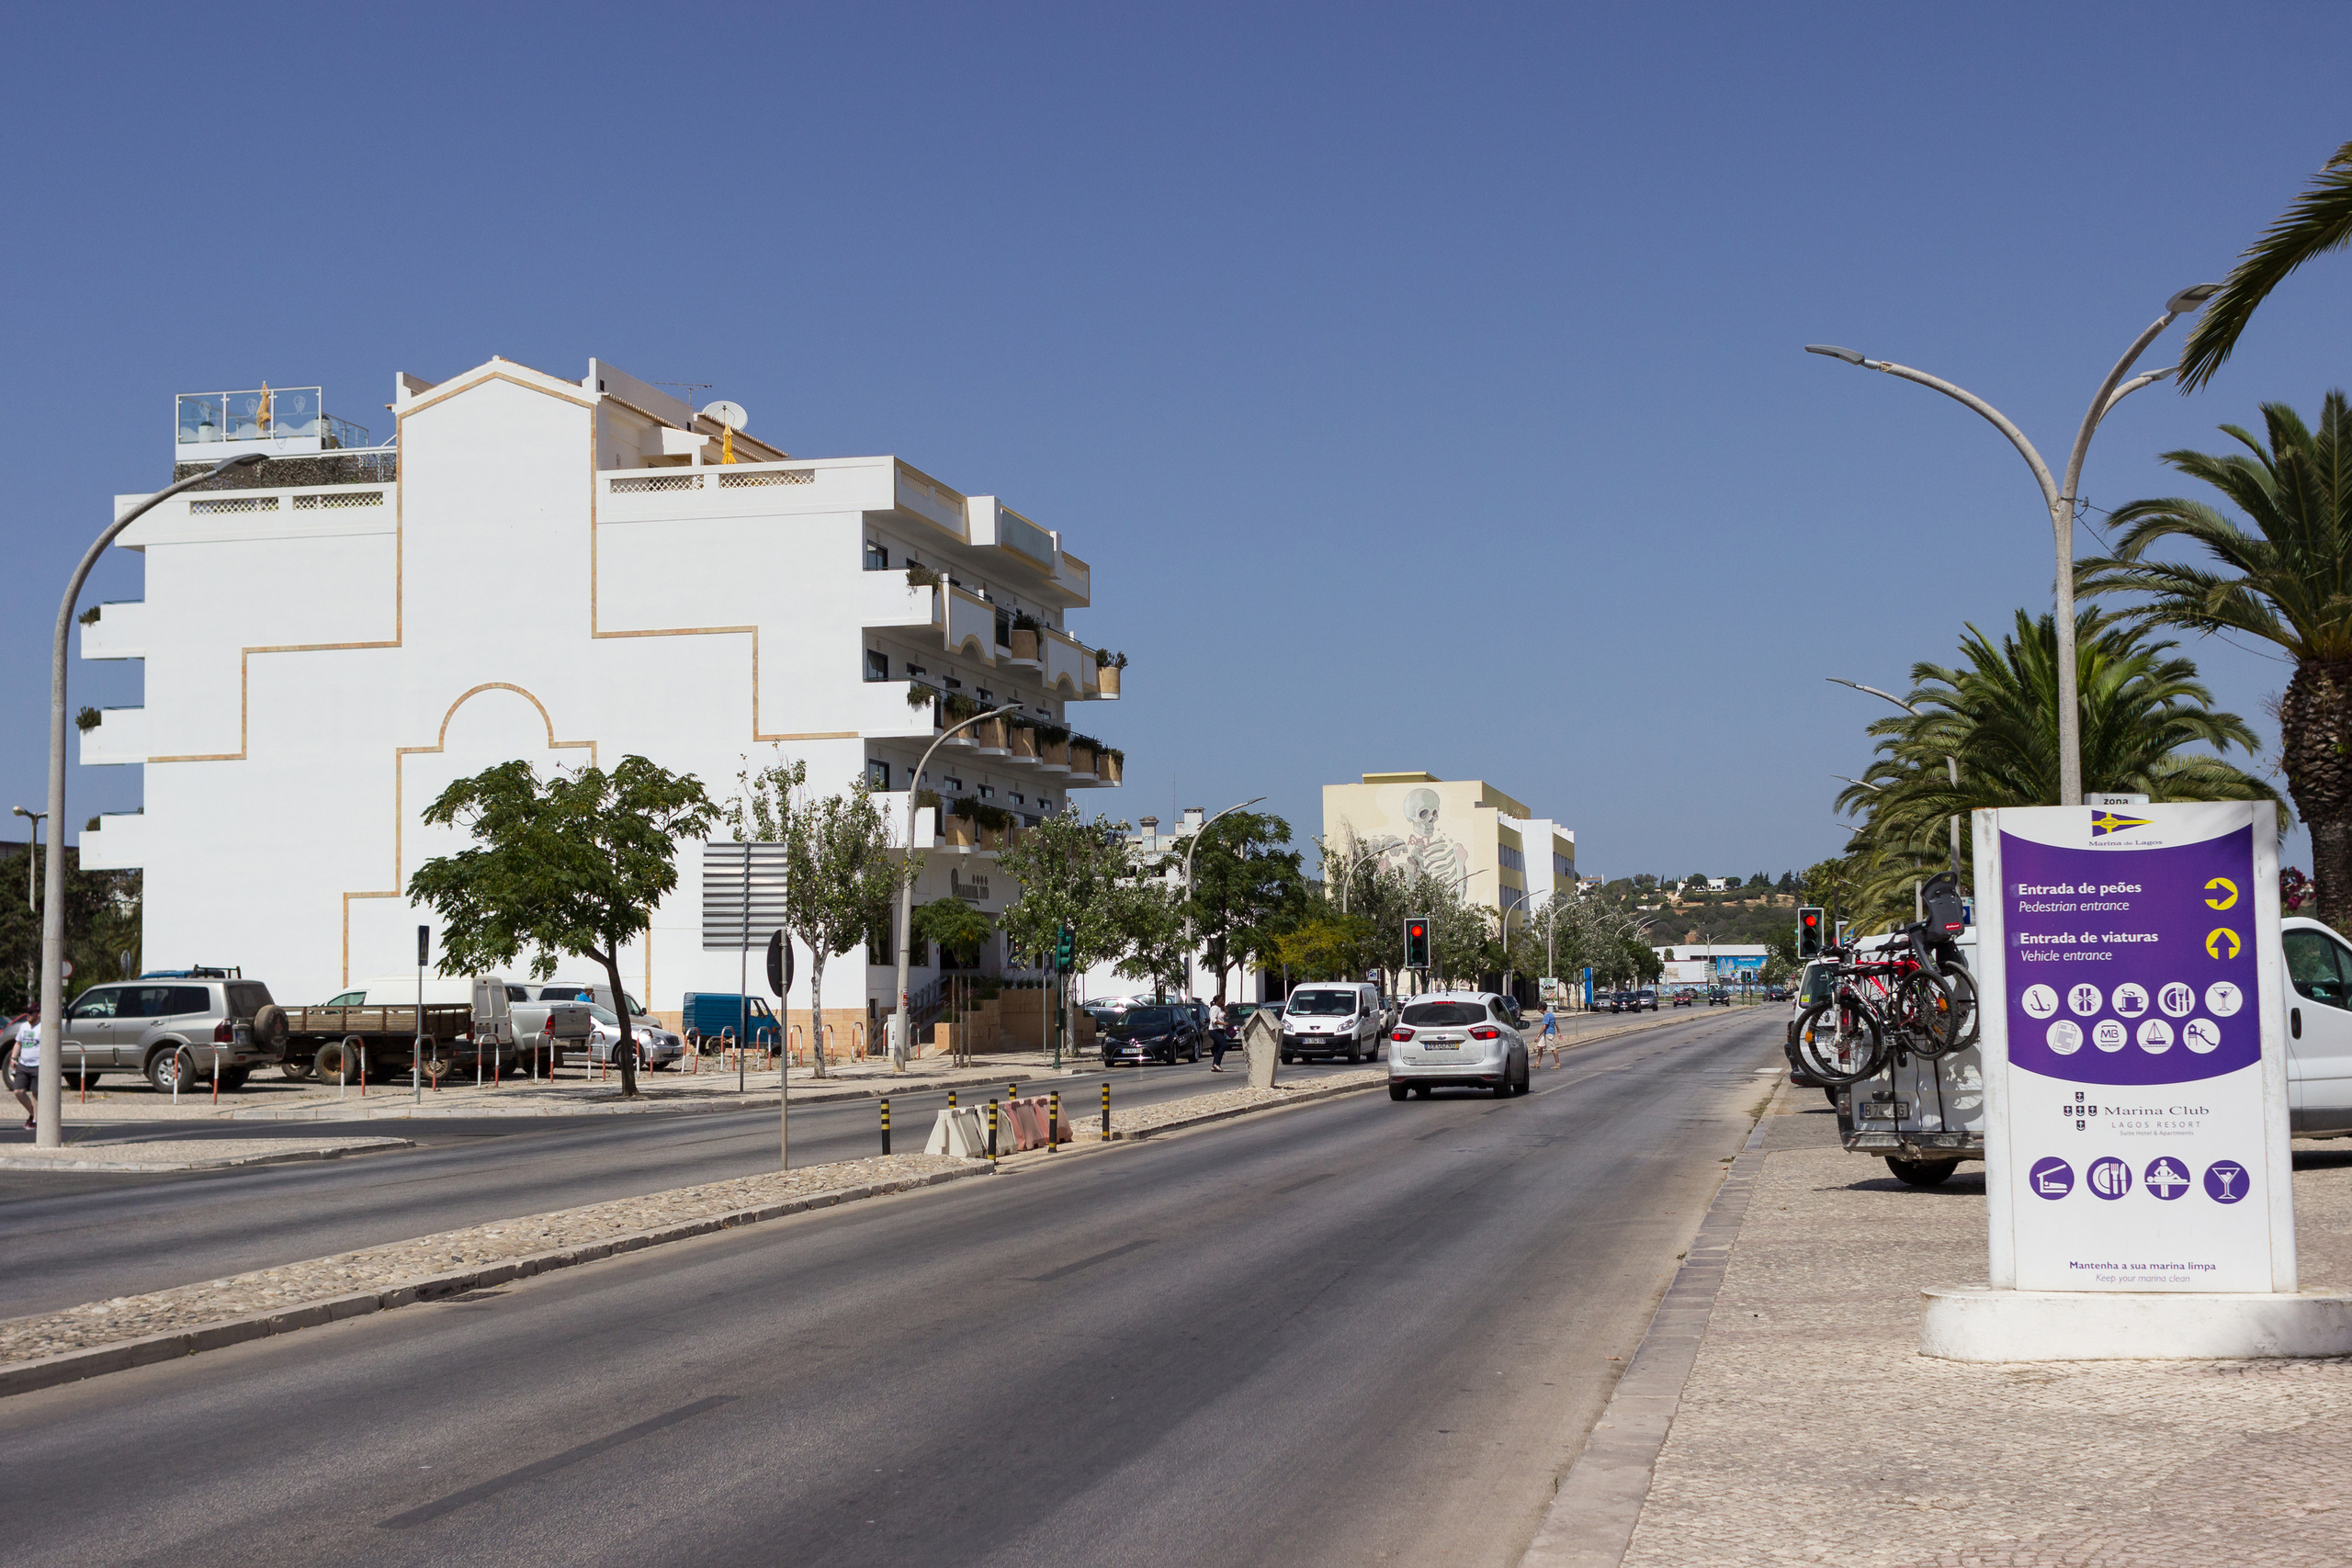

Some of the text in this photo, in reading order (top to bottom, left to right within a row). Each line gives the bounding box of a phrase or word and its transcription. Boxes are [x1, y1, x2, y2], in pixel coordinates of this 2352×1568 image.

[2018, 882, 2143, 897] Entrada de peões
[2018, 900, 2130, 912] Pedestrian entrance
[2019, 931, 2159, 944] Entrada de viaturas
[2020, 950, 2113, 962] Vehicle entrance
[2100, 1029, 2120, 1038] MB
[1865, 1105, 1871, 1116] B
[2104, 1106, 2210, 1115] Marina Club
[2069, 1261, 2120, 1269] Mantenha
[2150, 1262, 2186, 1270] marina
[2188, 1262, 2217, 1272] limpa
[2095, 1274, 2190, 1284] Keep your marina clean
